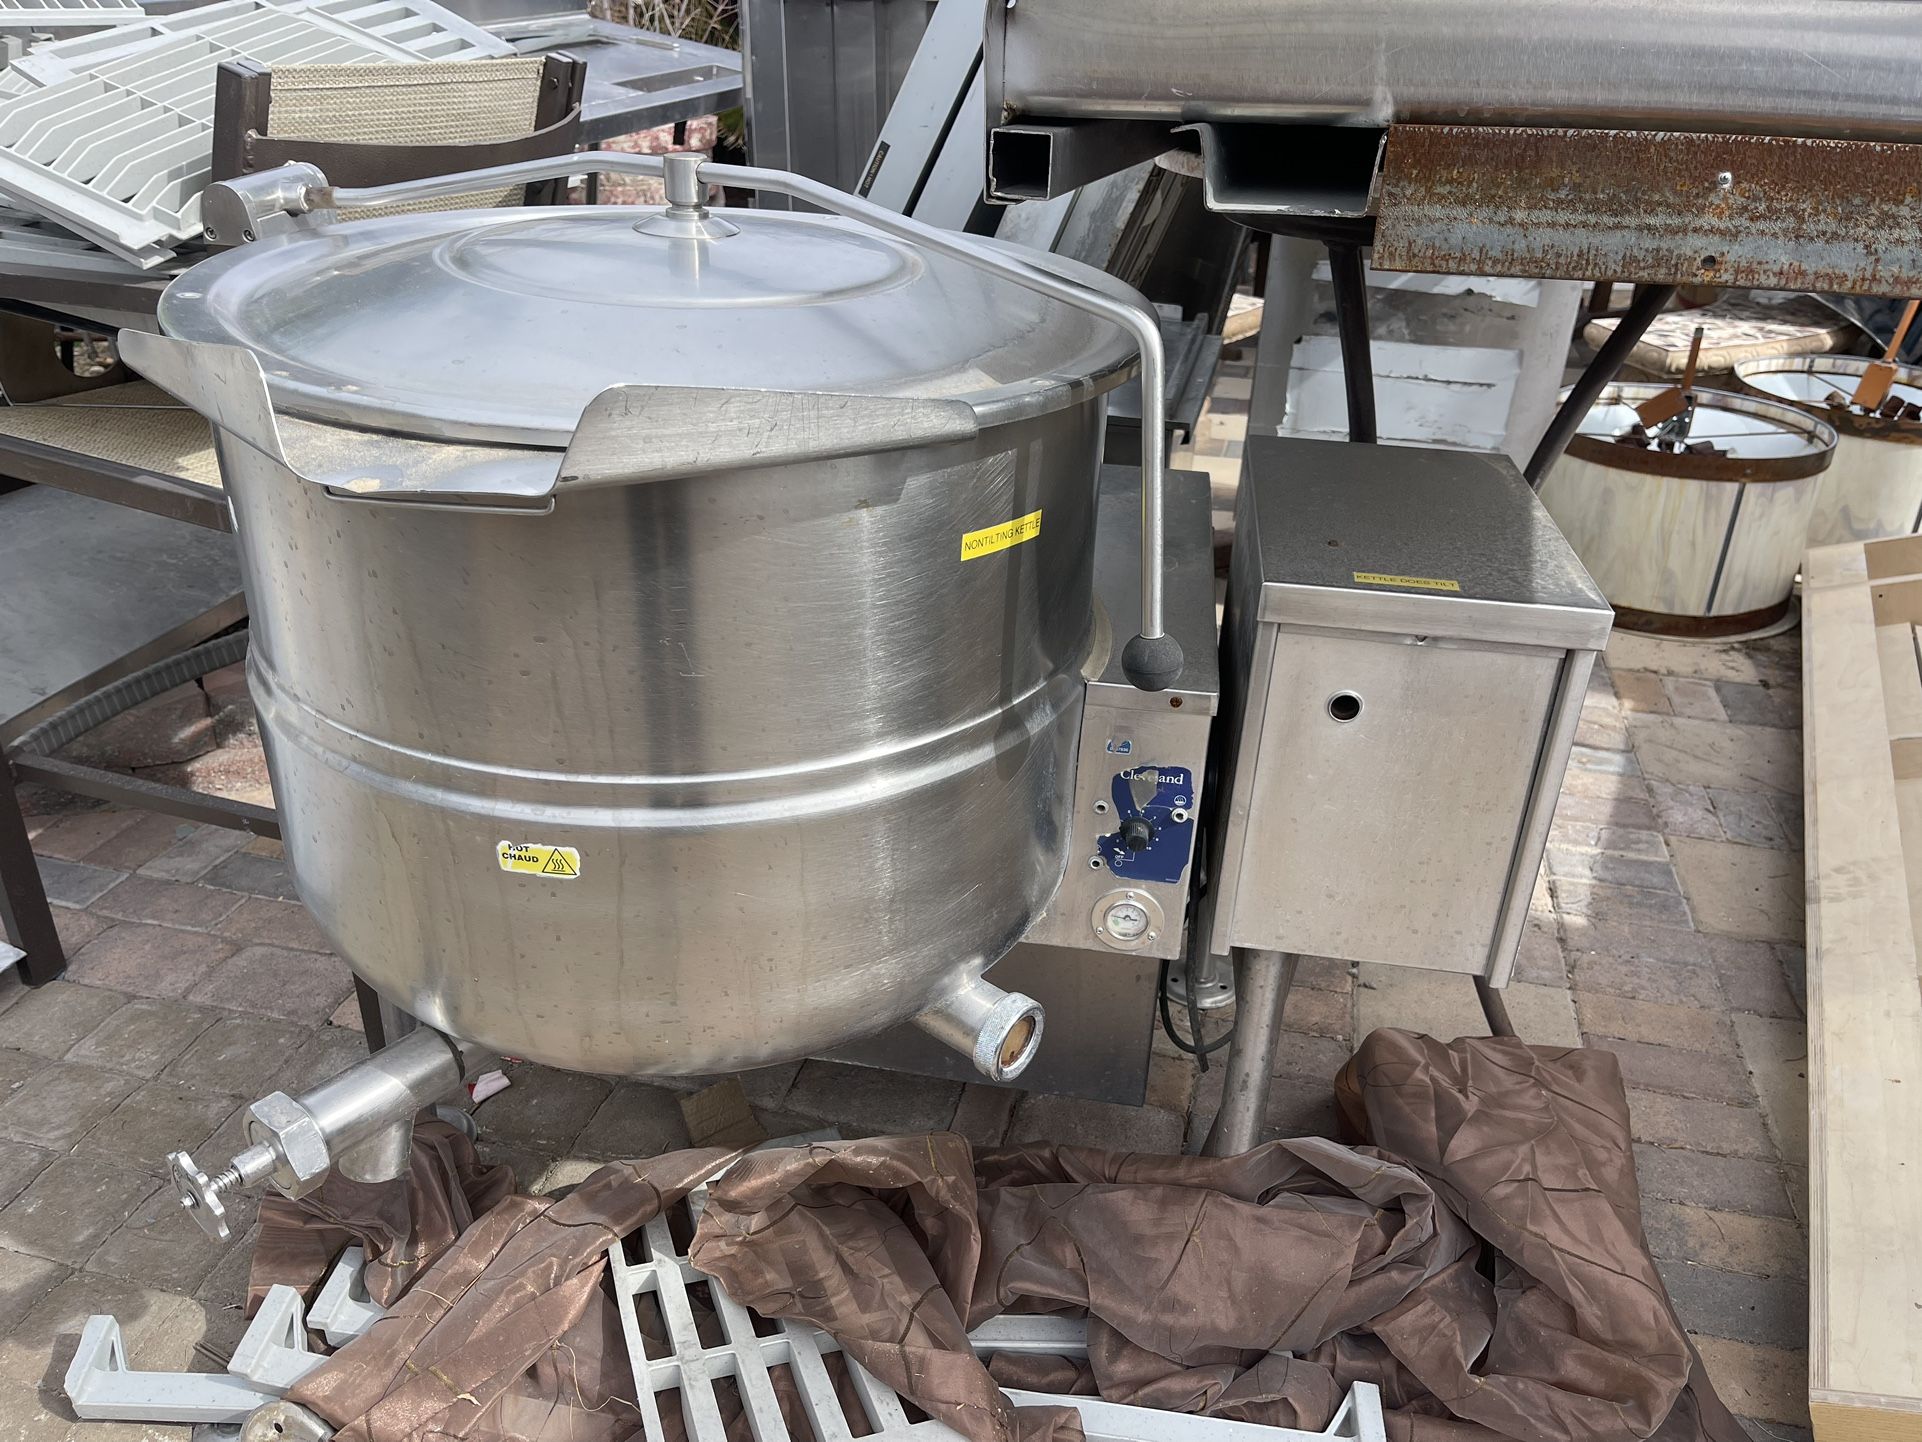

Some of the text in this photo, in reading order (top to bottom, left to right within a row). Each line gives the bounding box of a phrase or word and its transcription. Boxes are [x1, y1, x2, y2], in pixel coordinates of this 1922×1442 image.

[964, 517, 1040, 552] NONTILTING KETTLE
[1356, 575, 1394, 583] KETTLE
[502, 852, 539, 863] CHAUD
